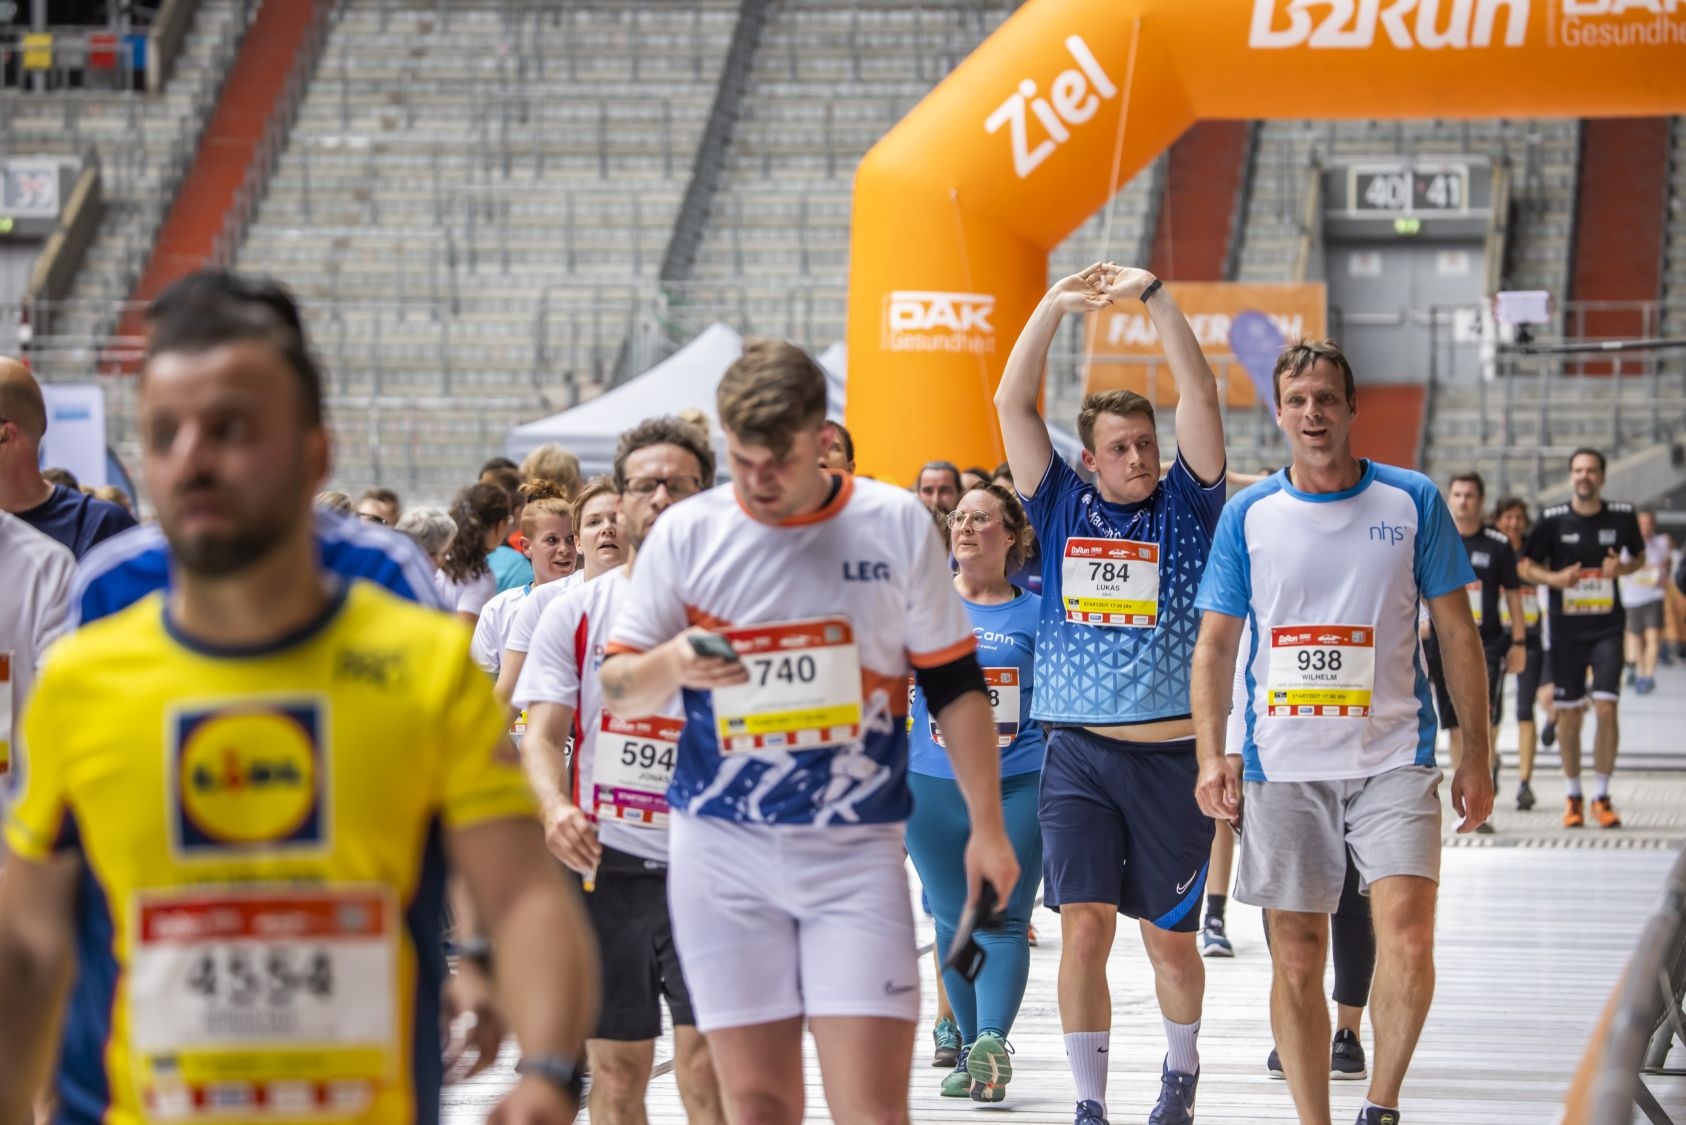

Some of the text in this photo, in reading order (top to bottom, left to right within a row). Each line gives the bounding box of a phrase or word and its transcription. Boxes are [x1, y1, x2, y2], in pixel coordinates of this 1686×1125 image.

[1247, 0, 1530, 49] B2Run
[984, 34, 1118, 178] Ziel
[890, 290, 996, 332] DAK
[842, 560, 890, 582] LEG
[1089, 562, 1130, 582] 784
[1096, 584, 1121, 592] LUKAS
[754, 656, 817, 687] 740
[1297, 650, 1342, 671] 938
[621, 741, 676, 771] 594
